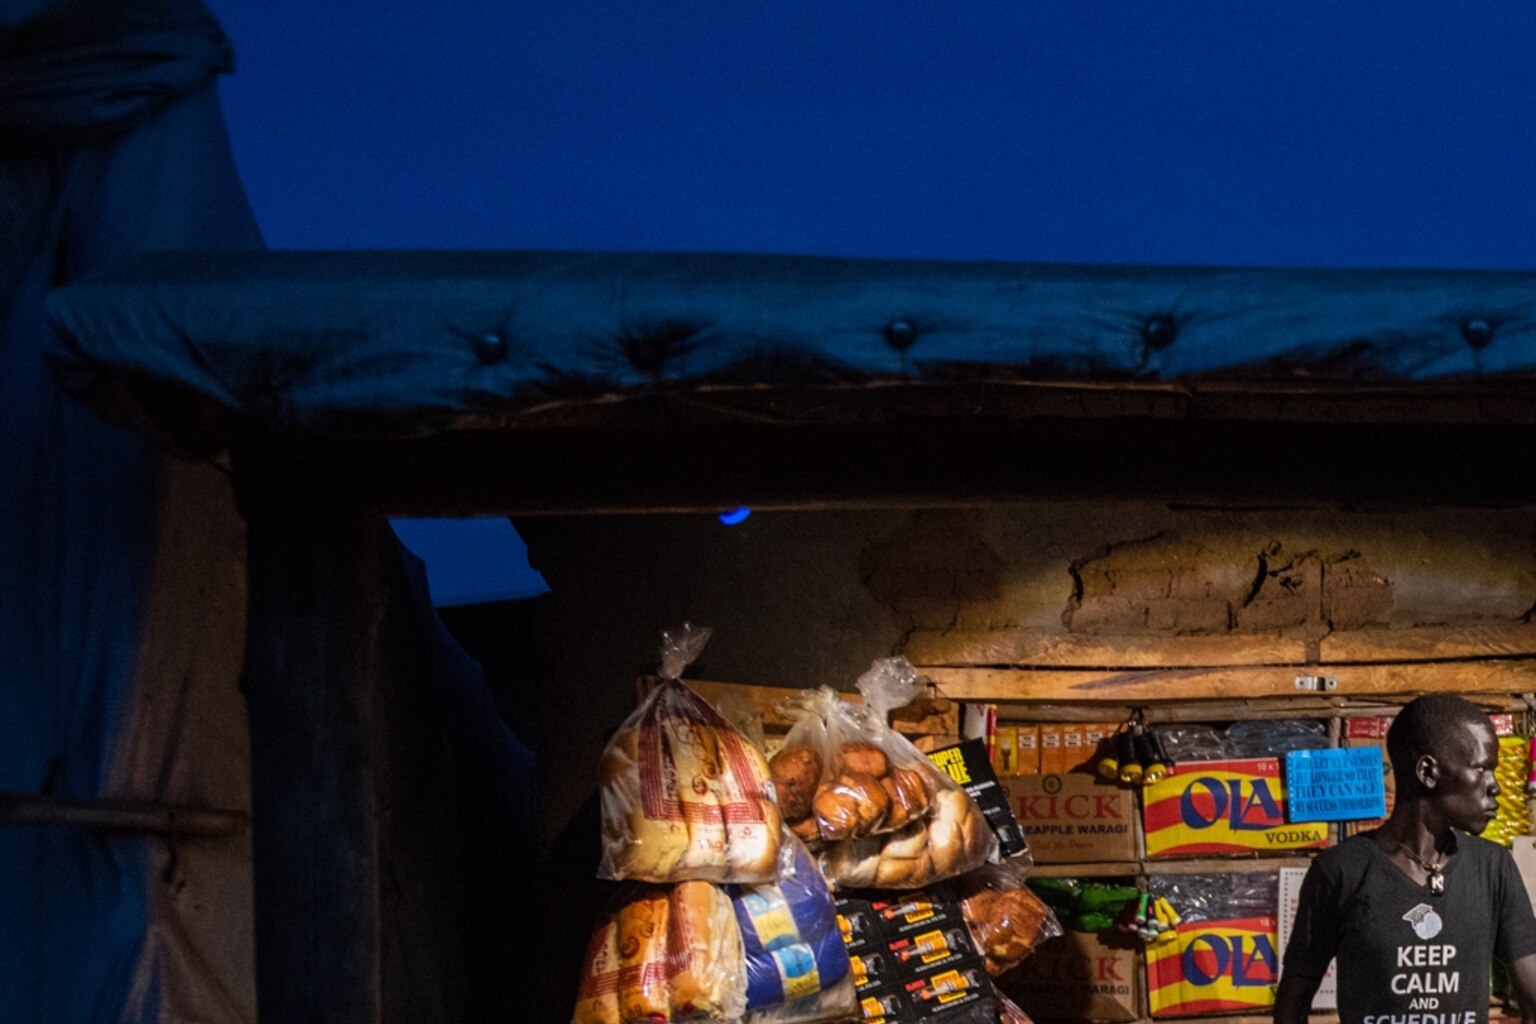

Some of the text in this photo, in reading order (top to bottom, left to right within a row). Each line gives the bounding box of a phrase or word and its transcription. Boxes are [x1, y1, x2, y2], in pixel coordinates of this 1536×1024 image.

[1295, 781, 1379, 799] THEY CAN SEE
[1015, 795, 1122, 820] KICK
[1180, 777, 1284, 831] OLA
[1078, 824, 1128, 835] WARAGI
[1265, 830, 1322, 844] VODKA
[1183, 934, 1278, 987] OLA
[1397, 945, 1457, 967] KEEP
[1391, 972, 1460, 994] CALM
[1408, 998, 1439, 1010] AND
